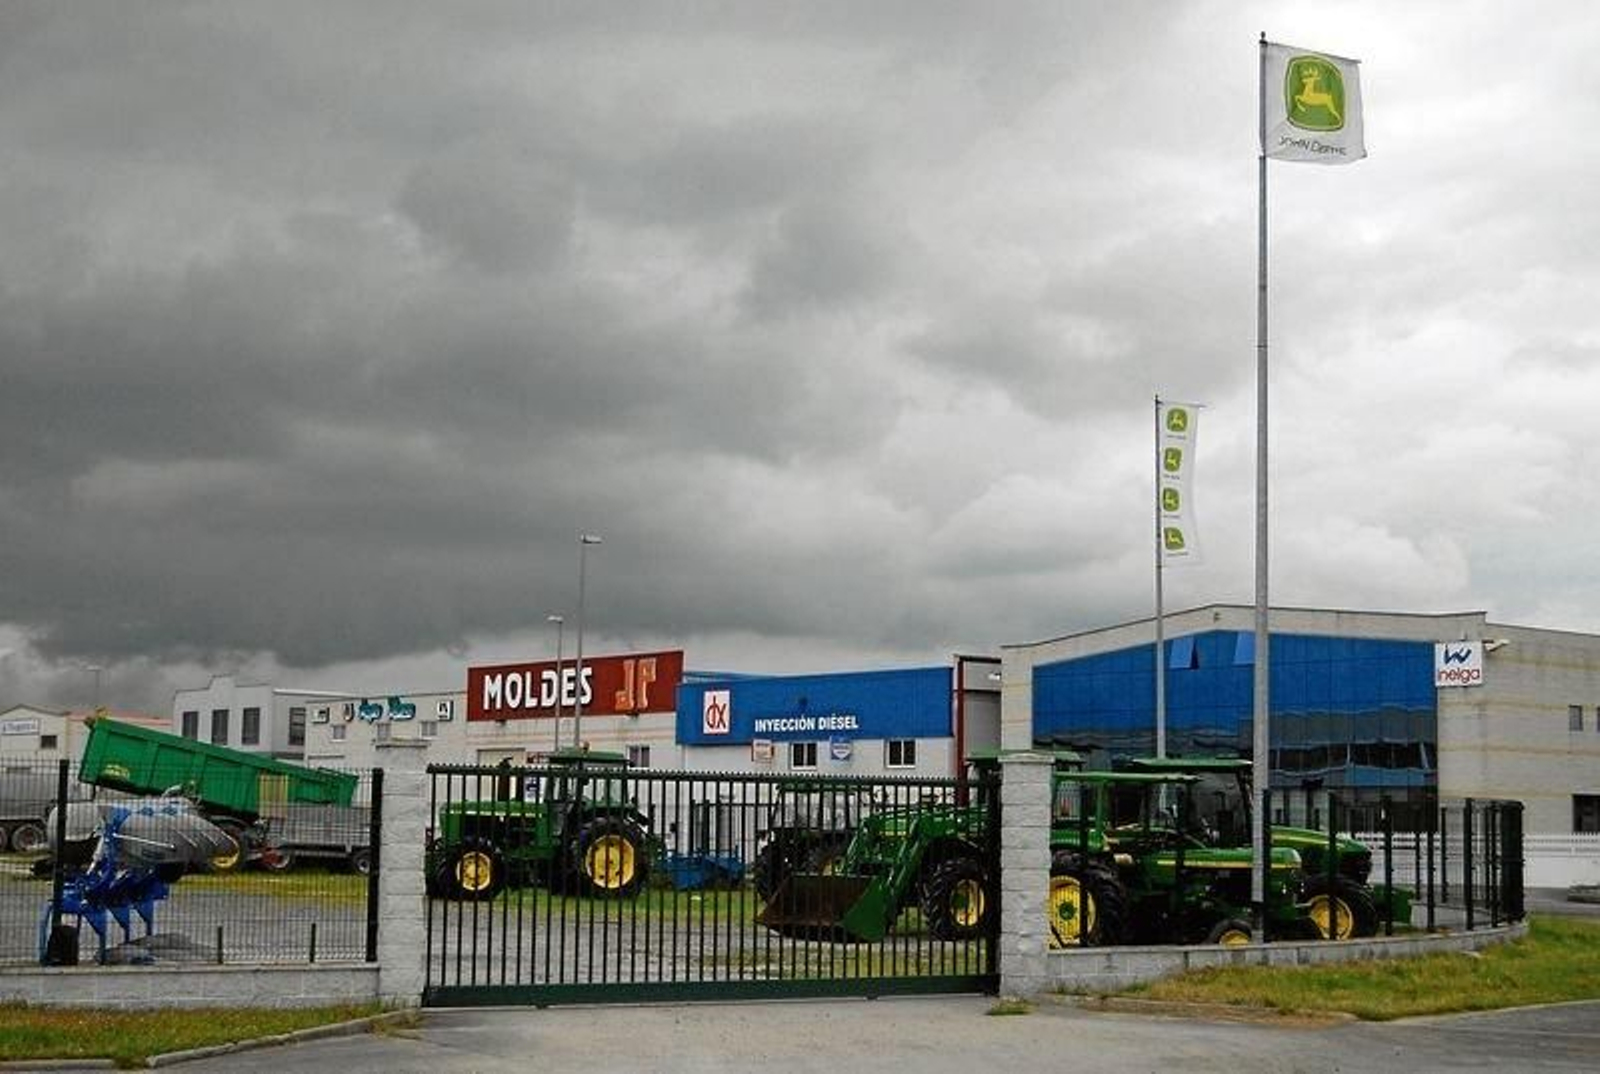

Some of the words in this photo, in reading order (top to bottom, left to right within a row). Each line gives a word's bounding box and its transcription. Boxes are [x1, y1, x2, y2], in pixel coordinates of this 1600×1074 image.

[483, 667, 592, 711] MOLDES
[755, 715, 815, 733] INYECCIÓN
[818, 713, 859, 730] DIÉSEL
